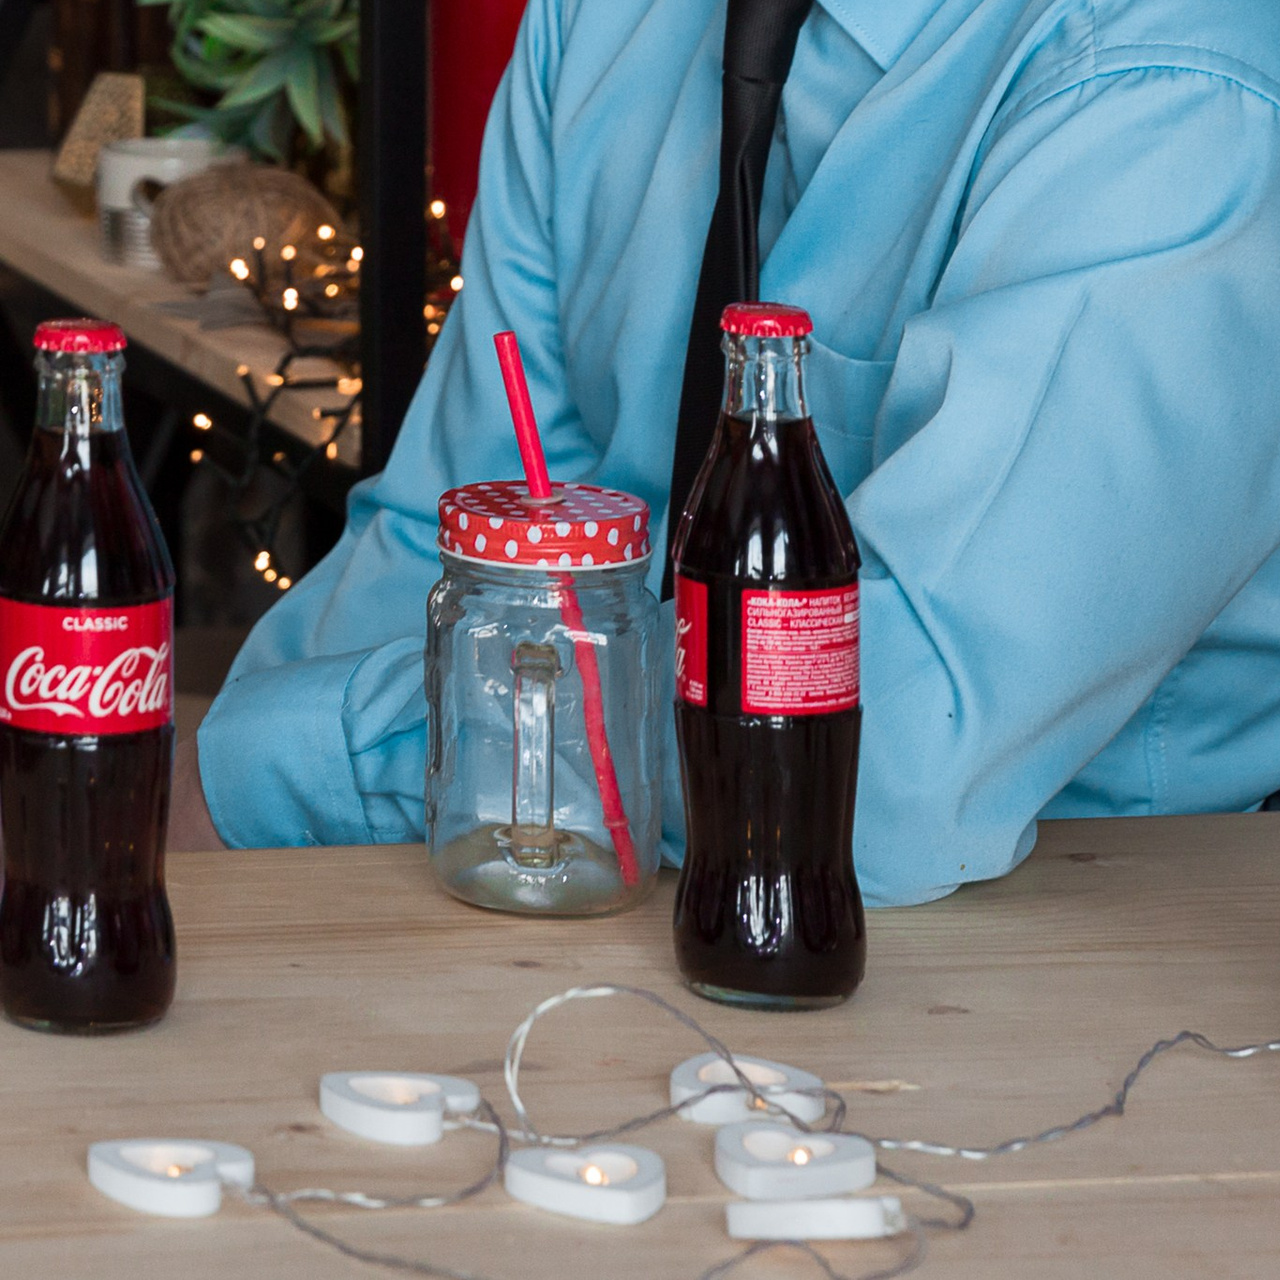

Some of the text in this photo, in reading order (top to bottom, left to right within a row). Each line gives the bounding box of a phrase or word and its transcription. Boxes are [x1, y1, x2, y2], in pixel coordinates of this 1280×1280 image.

[809, 596, 841, 606] НАПИТОК
[747, 604, 842, 617] СИЛЬНОГАЗИРОВАННЫЙ
[62, 616, 128, 631] CLASSIC
[747, 618, 782, 629] CLASSIC
[5, 642, 168, 718] Coca-Cola
